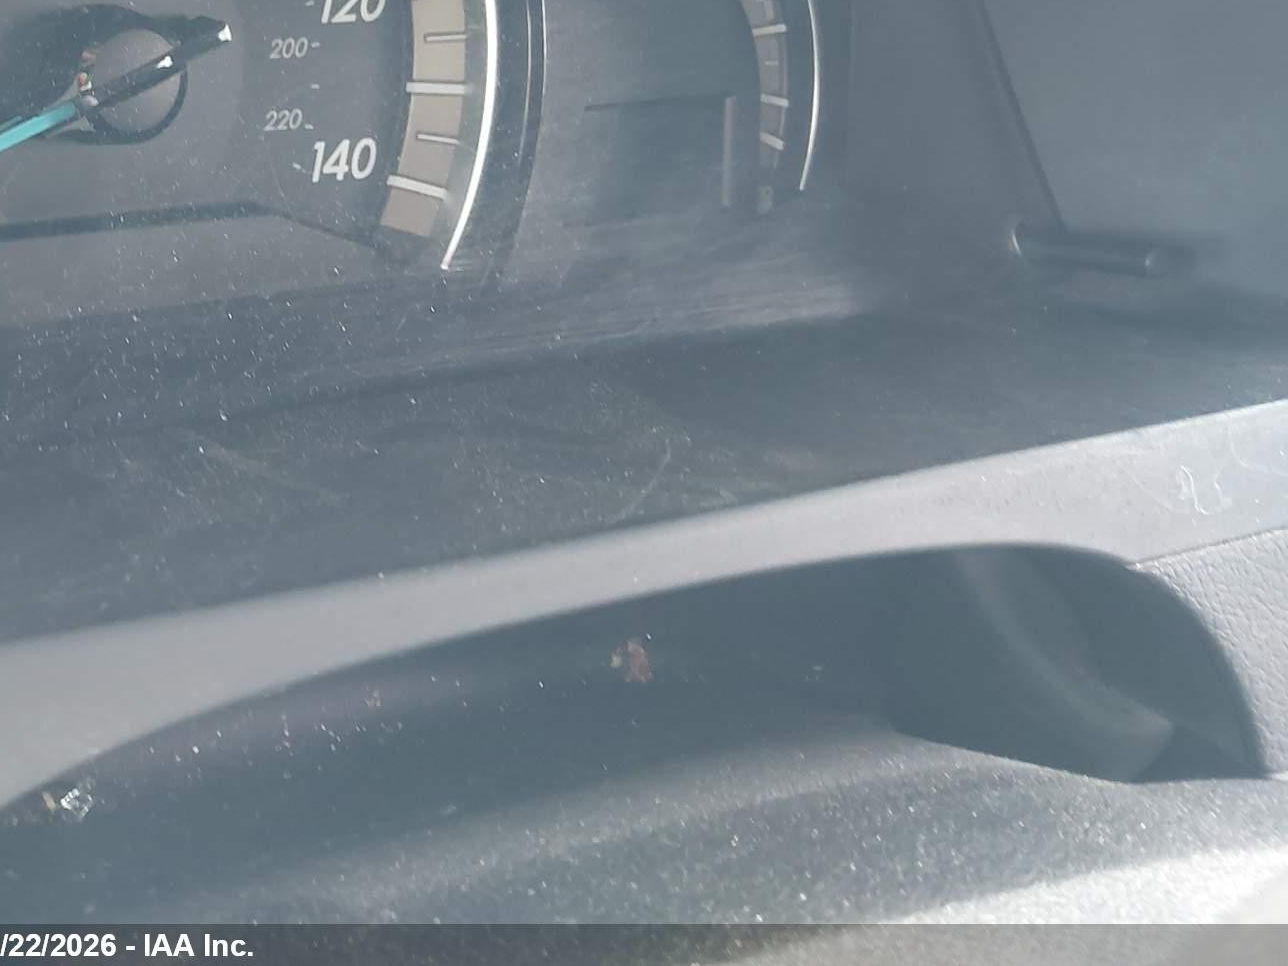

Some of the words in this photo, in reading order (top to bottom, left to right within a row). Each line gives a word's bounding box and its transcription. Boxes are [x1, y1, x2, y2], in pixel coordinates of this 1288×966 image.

[269, 36, 309, 59] 200
[263, 109, 303, 131] 220
[311, 138, 377, 182] 140
